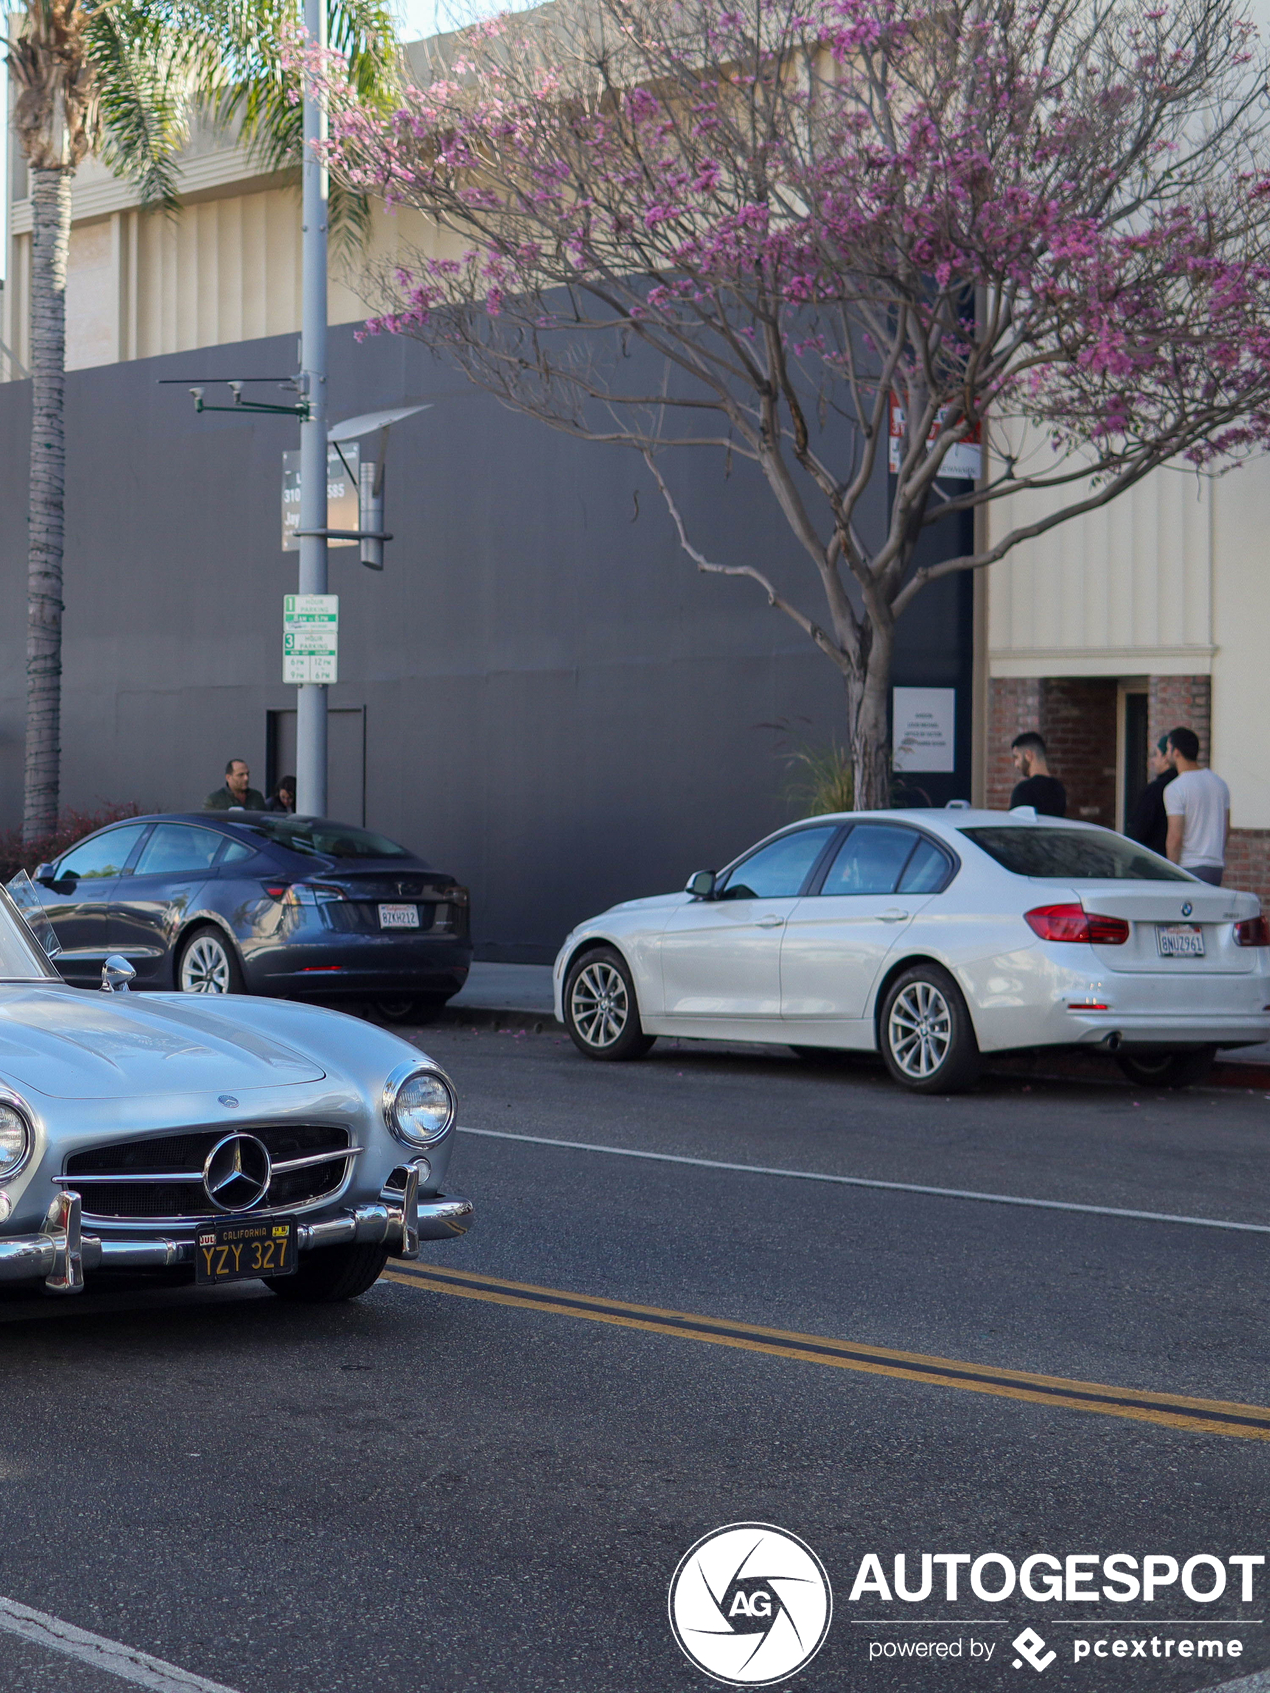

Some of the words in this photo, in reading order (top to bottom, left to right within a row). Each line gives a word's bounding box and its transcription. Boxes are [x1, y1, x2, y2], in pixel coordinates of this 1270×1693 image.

[1161, 936, 1203, 951] 8NUZ961
[200, 1234, 216, 1244] JUL
[223, 1227, 267, 1241] CALIFORNIA
[202, 1243, 244, 1276] YZY
[251, 1238, 288, 1270] 327
